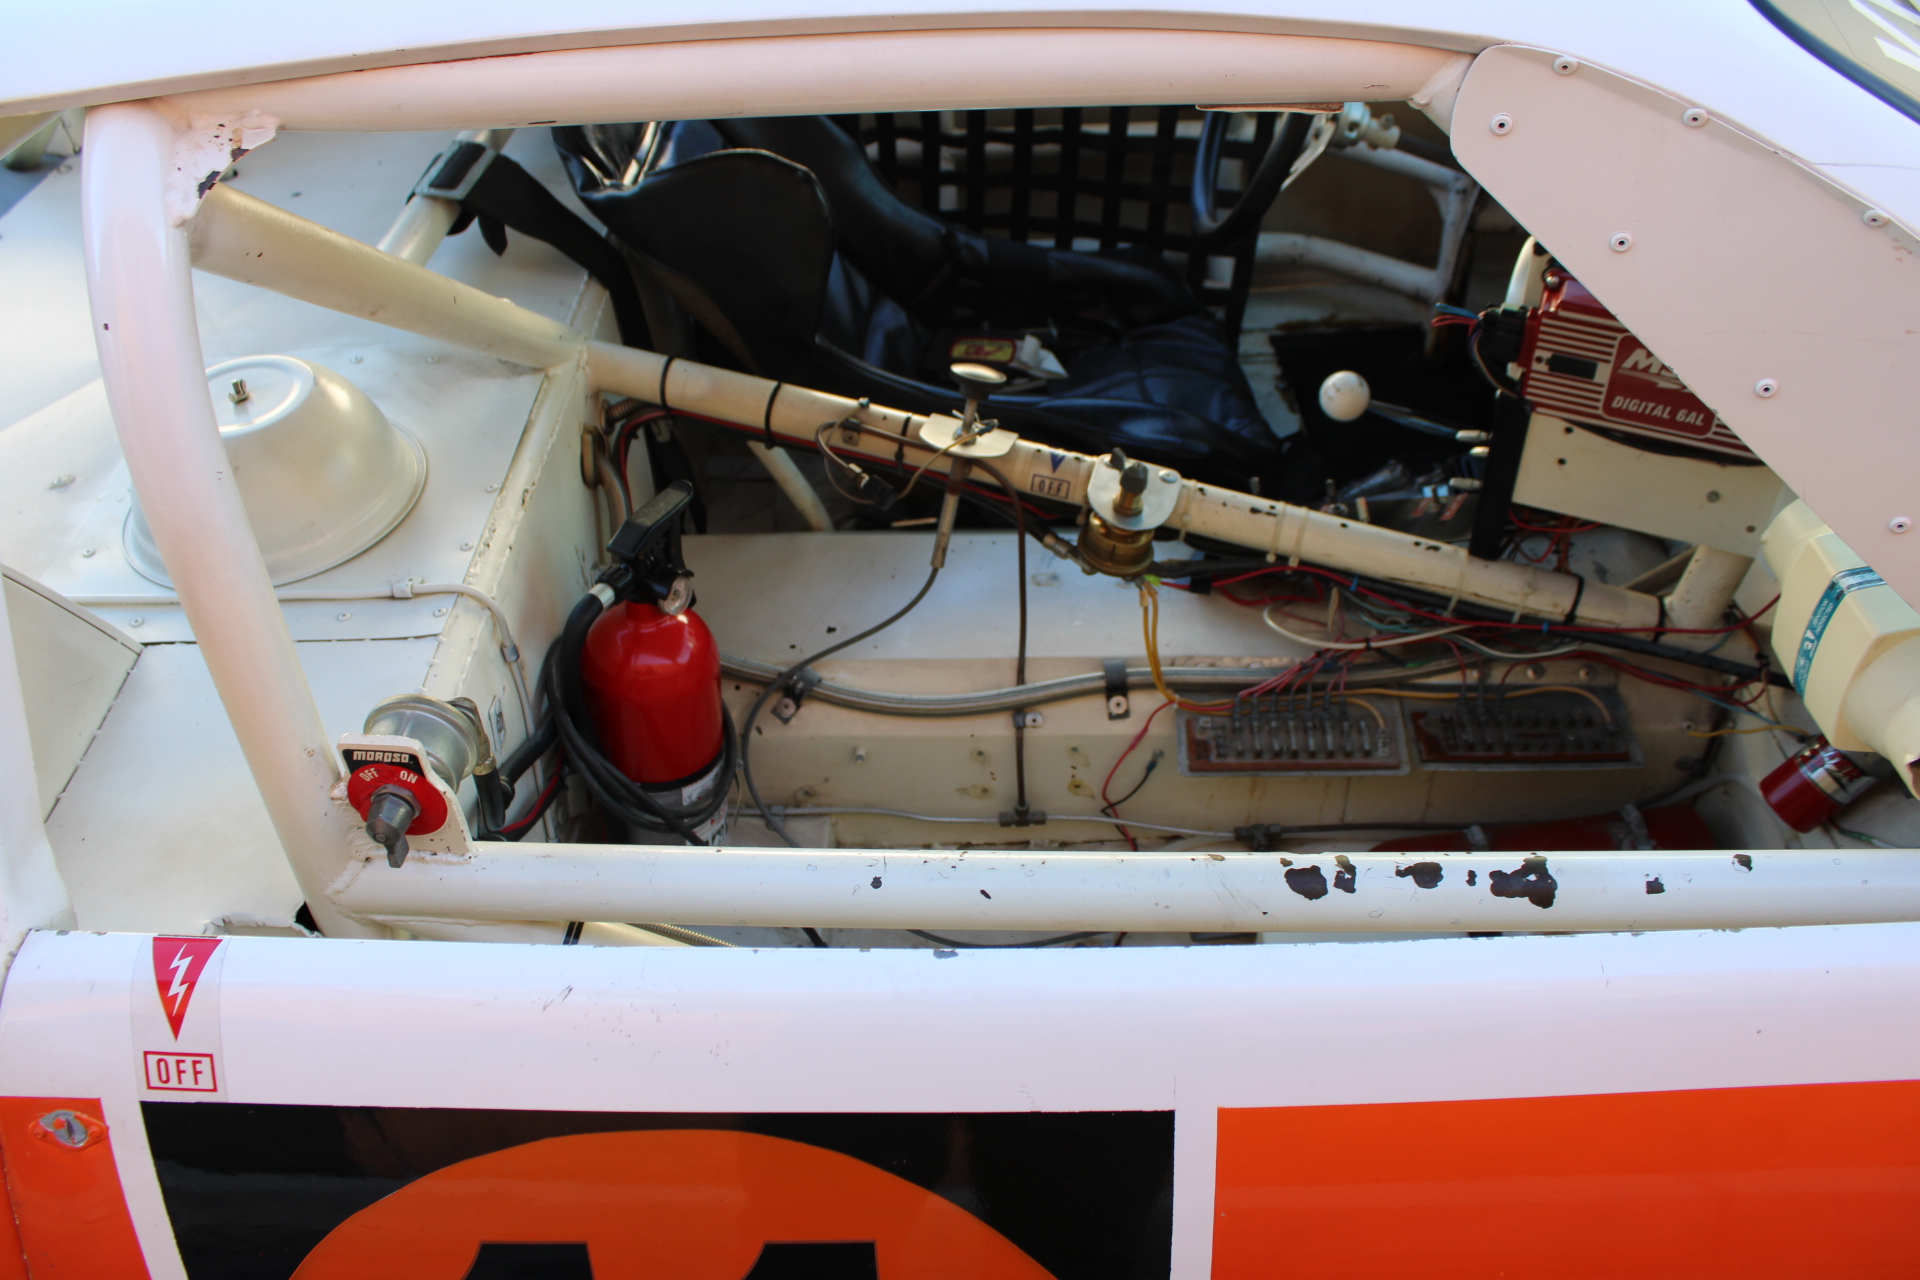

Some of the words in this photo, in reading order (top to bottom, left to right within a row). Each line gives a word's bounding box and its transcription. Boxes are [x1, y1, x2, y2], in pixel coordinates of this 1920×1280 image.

[1611, 396, 1672, 419] DIGITAL
[1675, 409, 1705, 426] 6AL
[1038, 479, 1064, 496] OFF
[353, 751, 409, 763] MOROSO
[359, 767, 379, 782] OFF
[400, 770, 418, 784] ON
[156, 1058, 203, 1085] OFF
